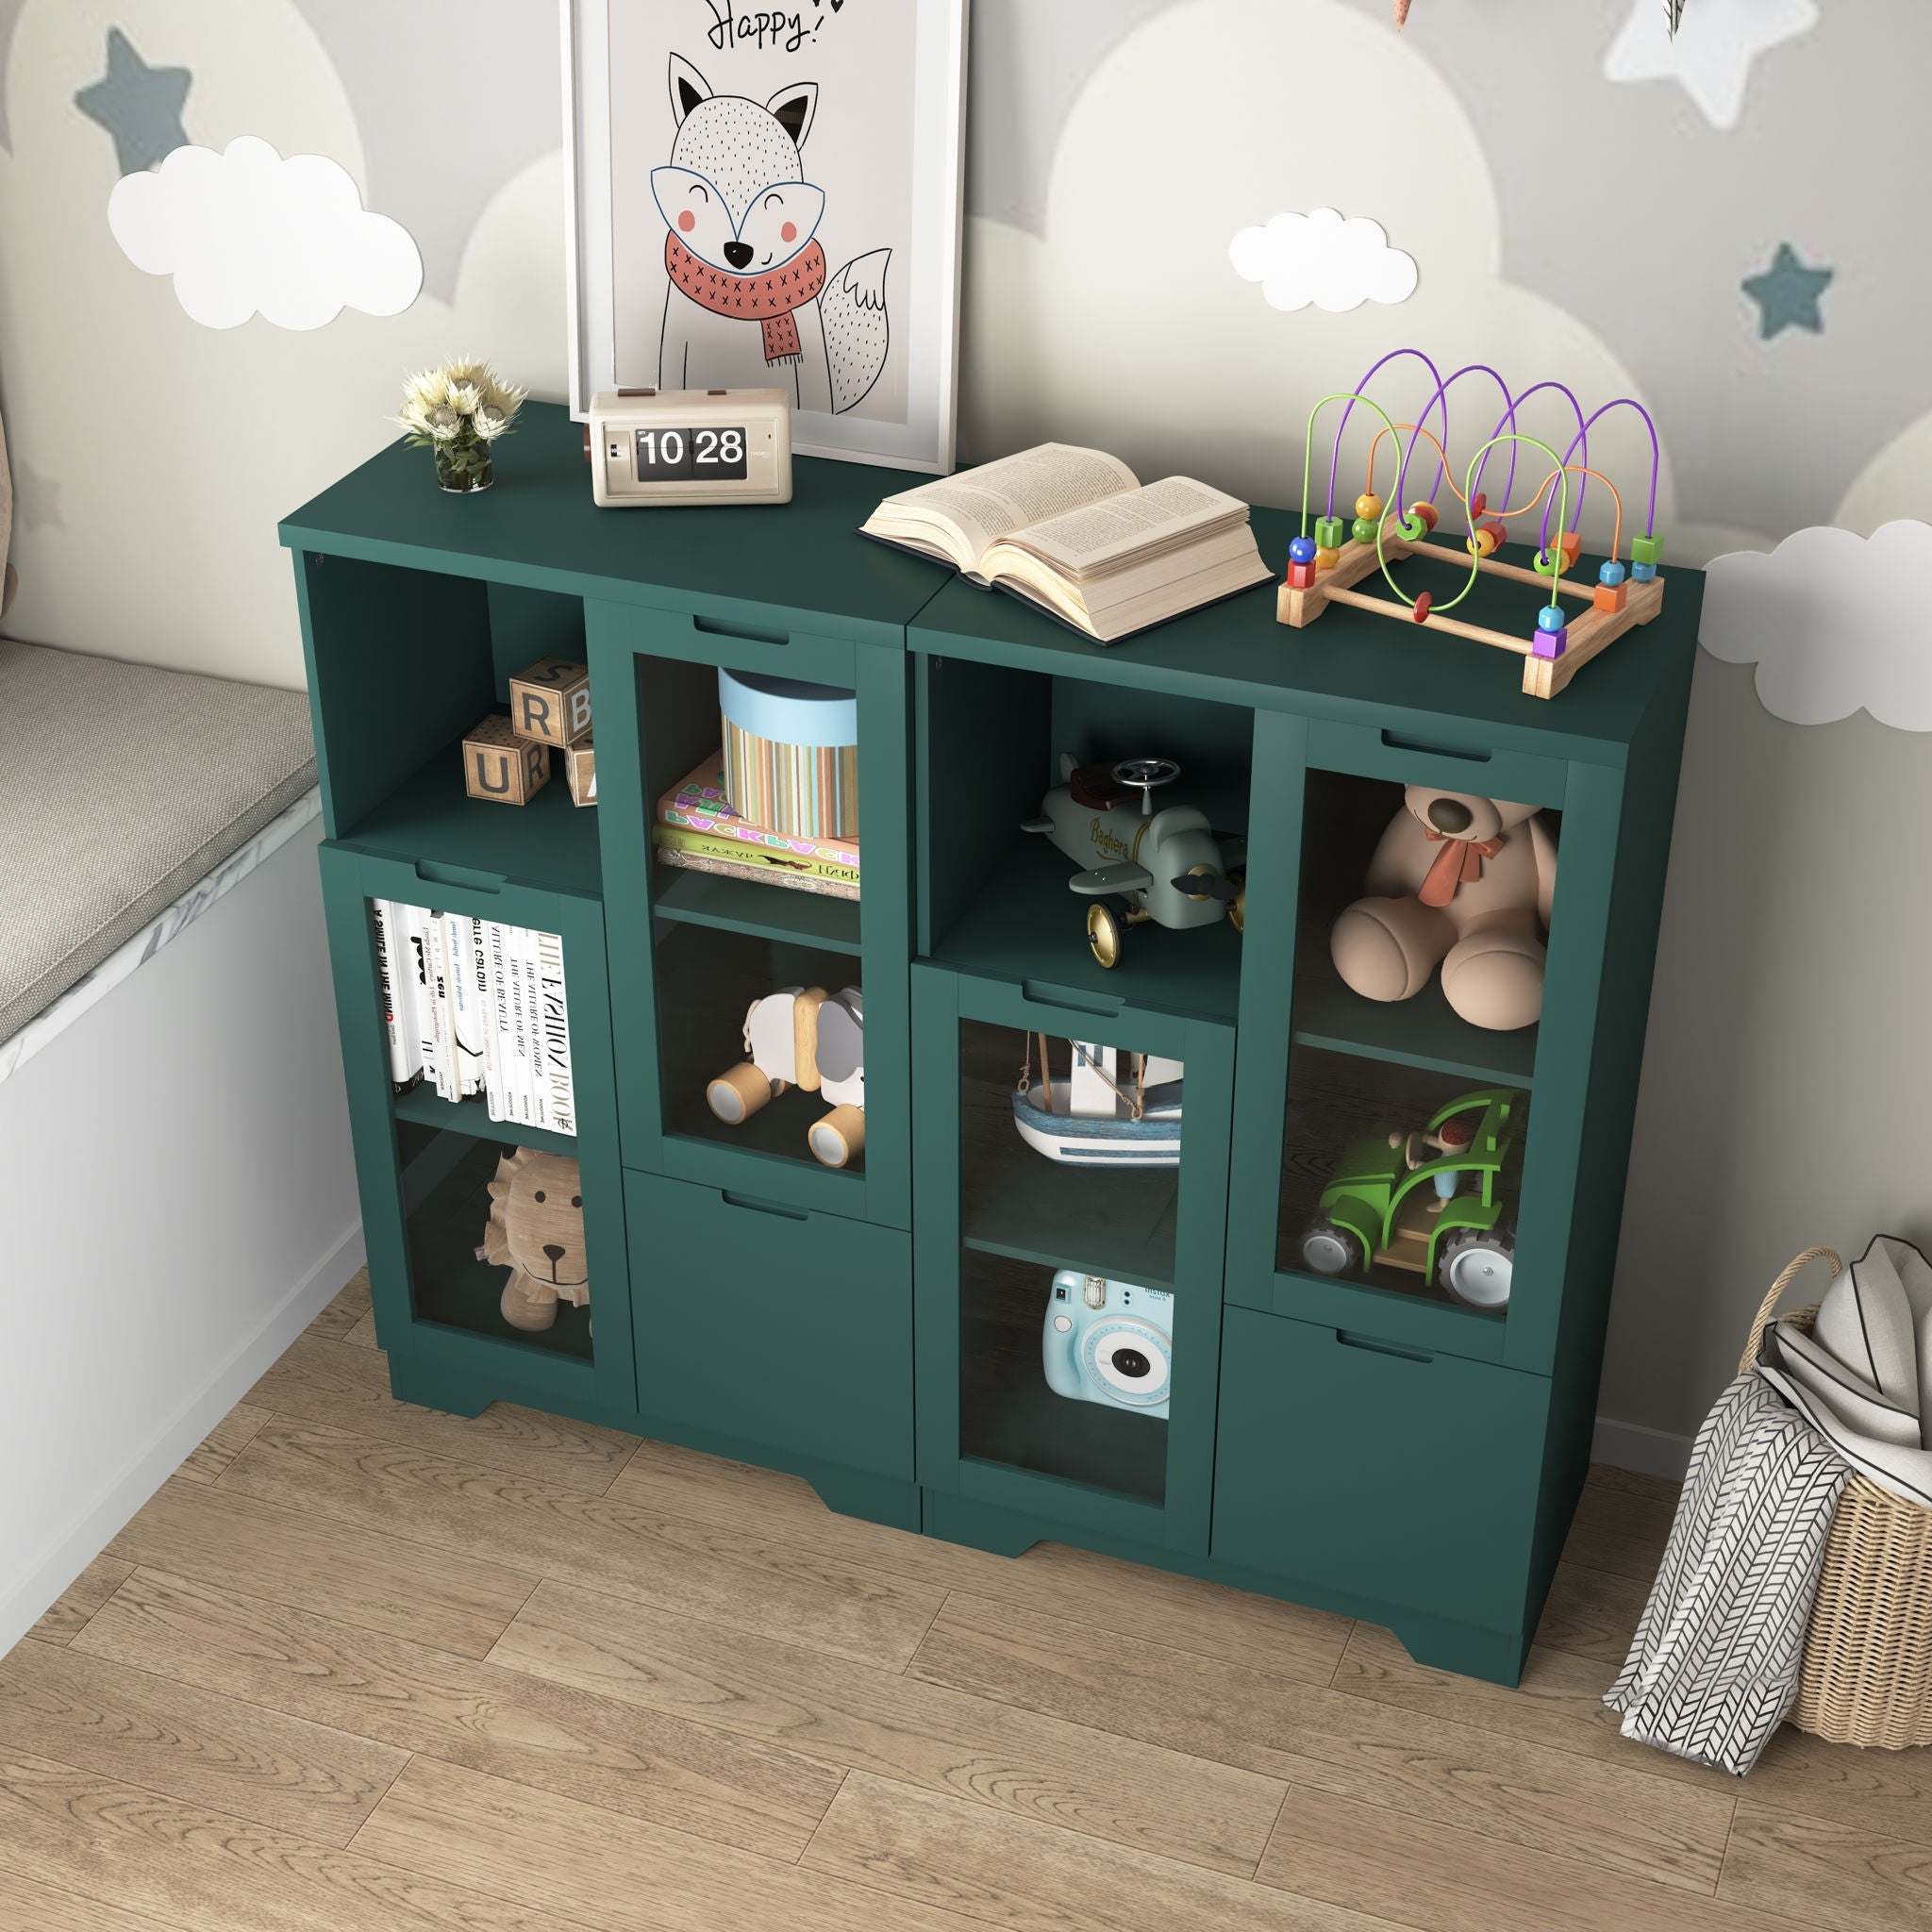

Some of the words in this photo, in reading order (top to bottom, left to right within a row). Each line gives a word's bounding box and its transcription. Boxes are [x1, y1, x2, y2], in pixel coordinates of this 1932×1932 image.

[708, 0, 824, 52] Happy!
[640, 431, 684, 464] 10
[695, 430, 743, 463] 28
[522, 692, 552, 736] R
[571, 688, 591, 733] B
[476, 753, 509, 794] U
[1091, 817, 1128, 859] Baghera
